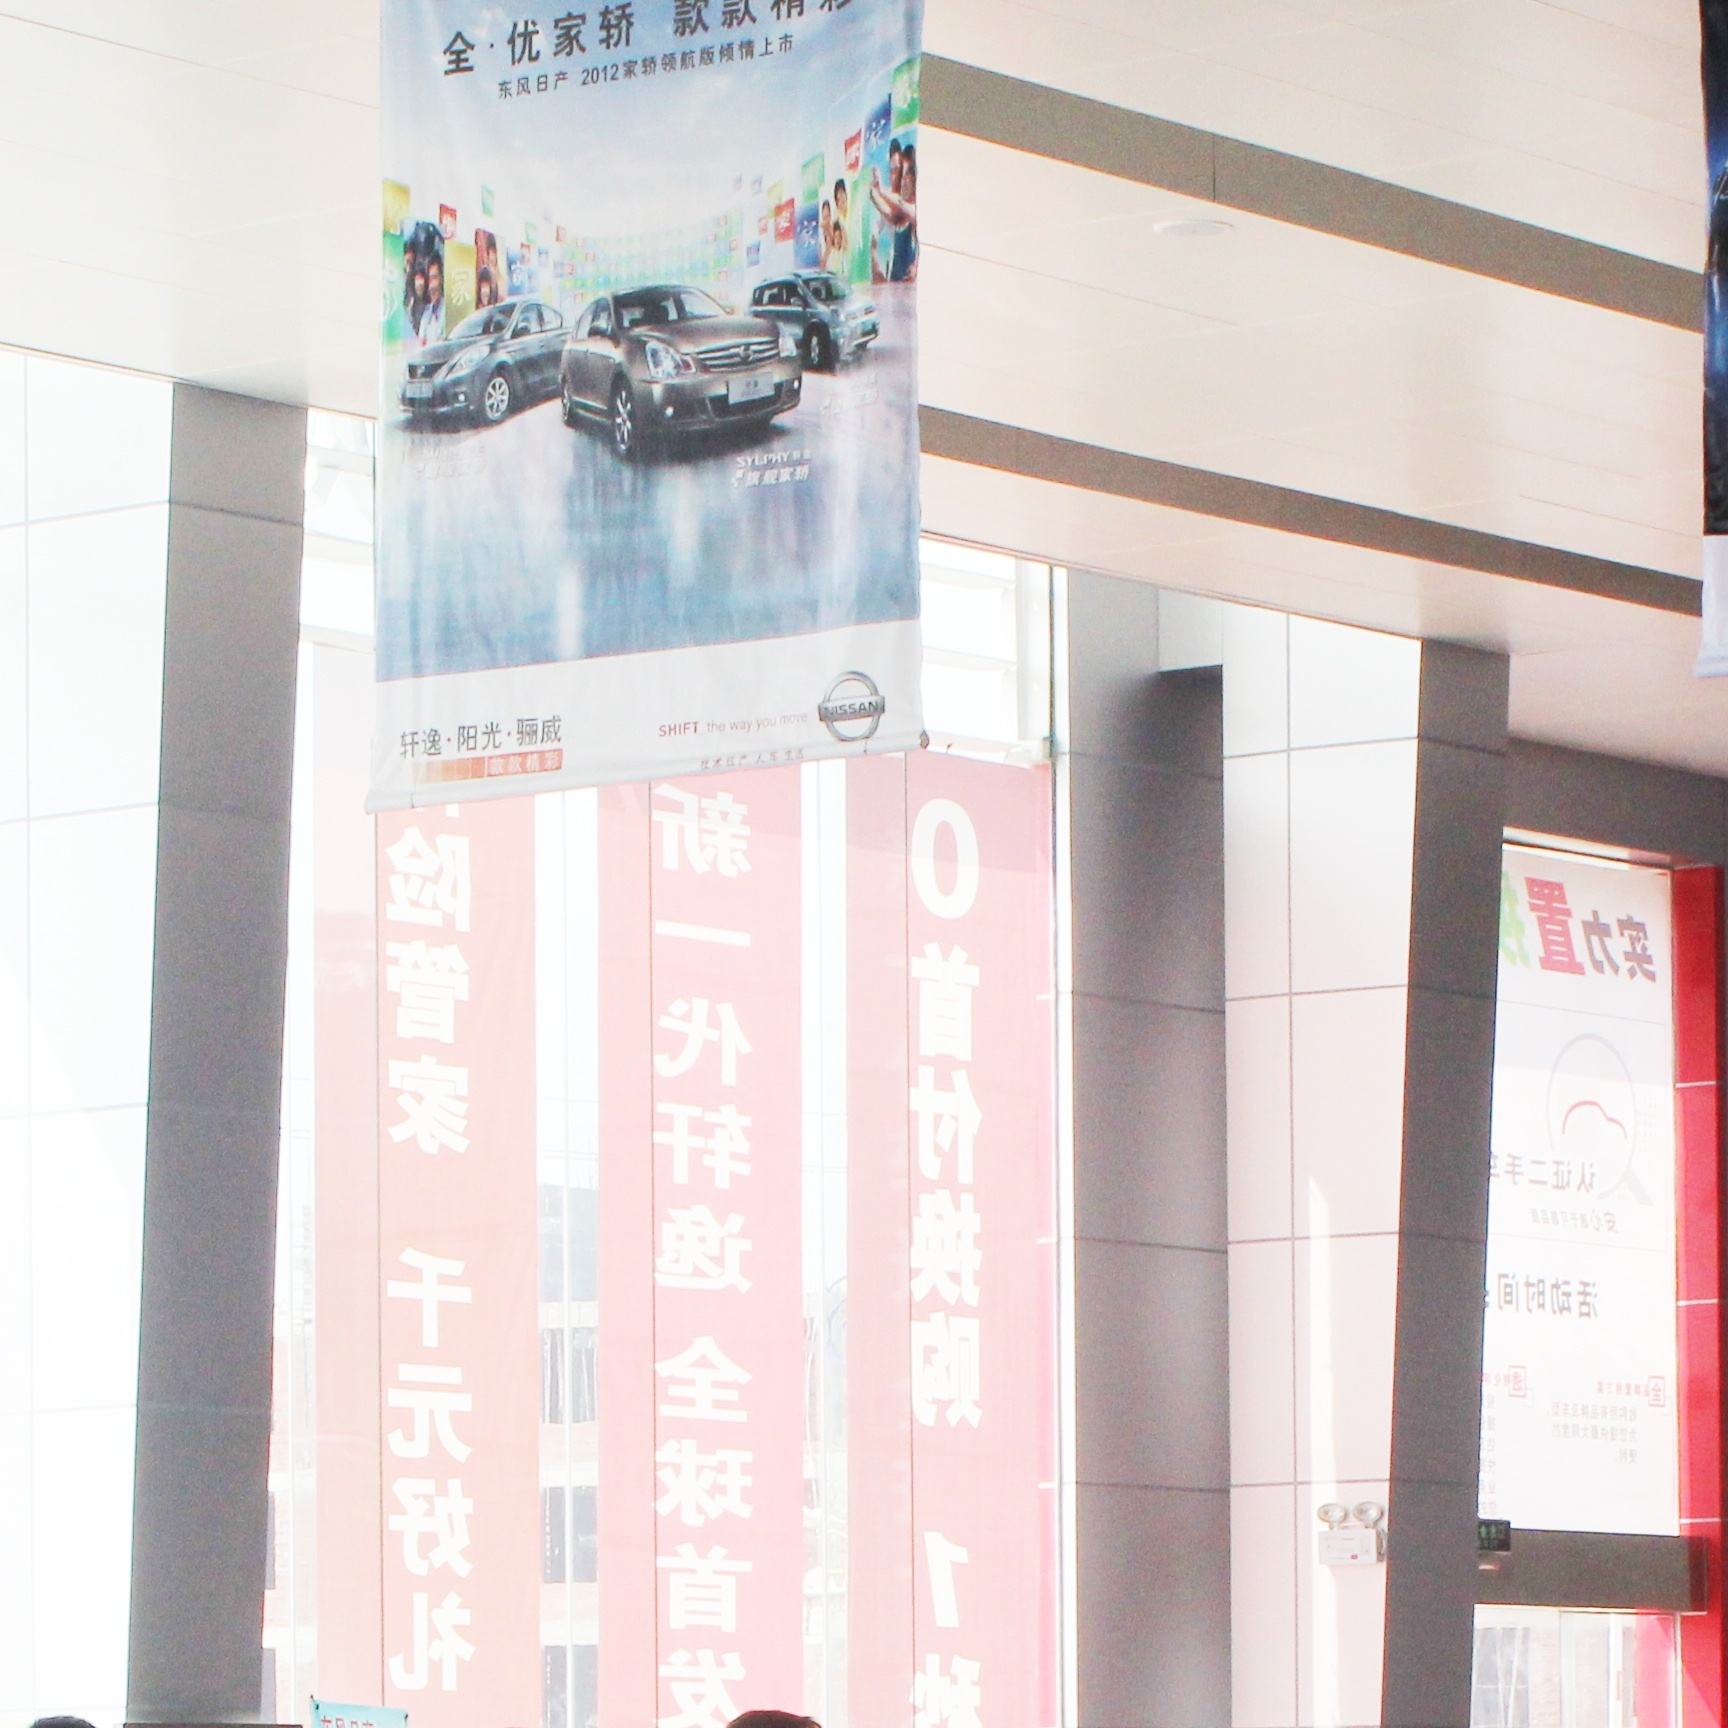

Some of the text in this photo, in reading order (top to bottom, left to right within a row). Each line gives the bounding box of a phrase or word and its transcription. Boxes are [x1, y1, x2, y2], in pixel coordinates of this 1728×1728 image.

[674, 0, 856, 37] 款款
[497, 71, 570, 100] 东风日产
[824, 700, 879, 717] NISSAN
[729, 719, 757, 735] way
[757, 715, 777, 732] you
[779, 711, 808, 727] move
